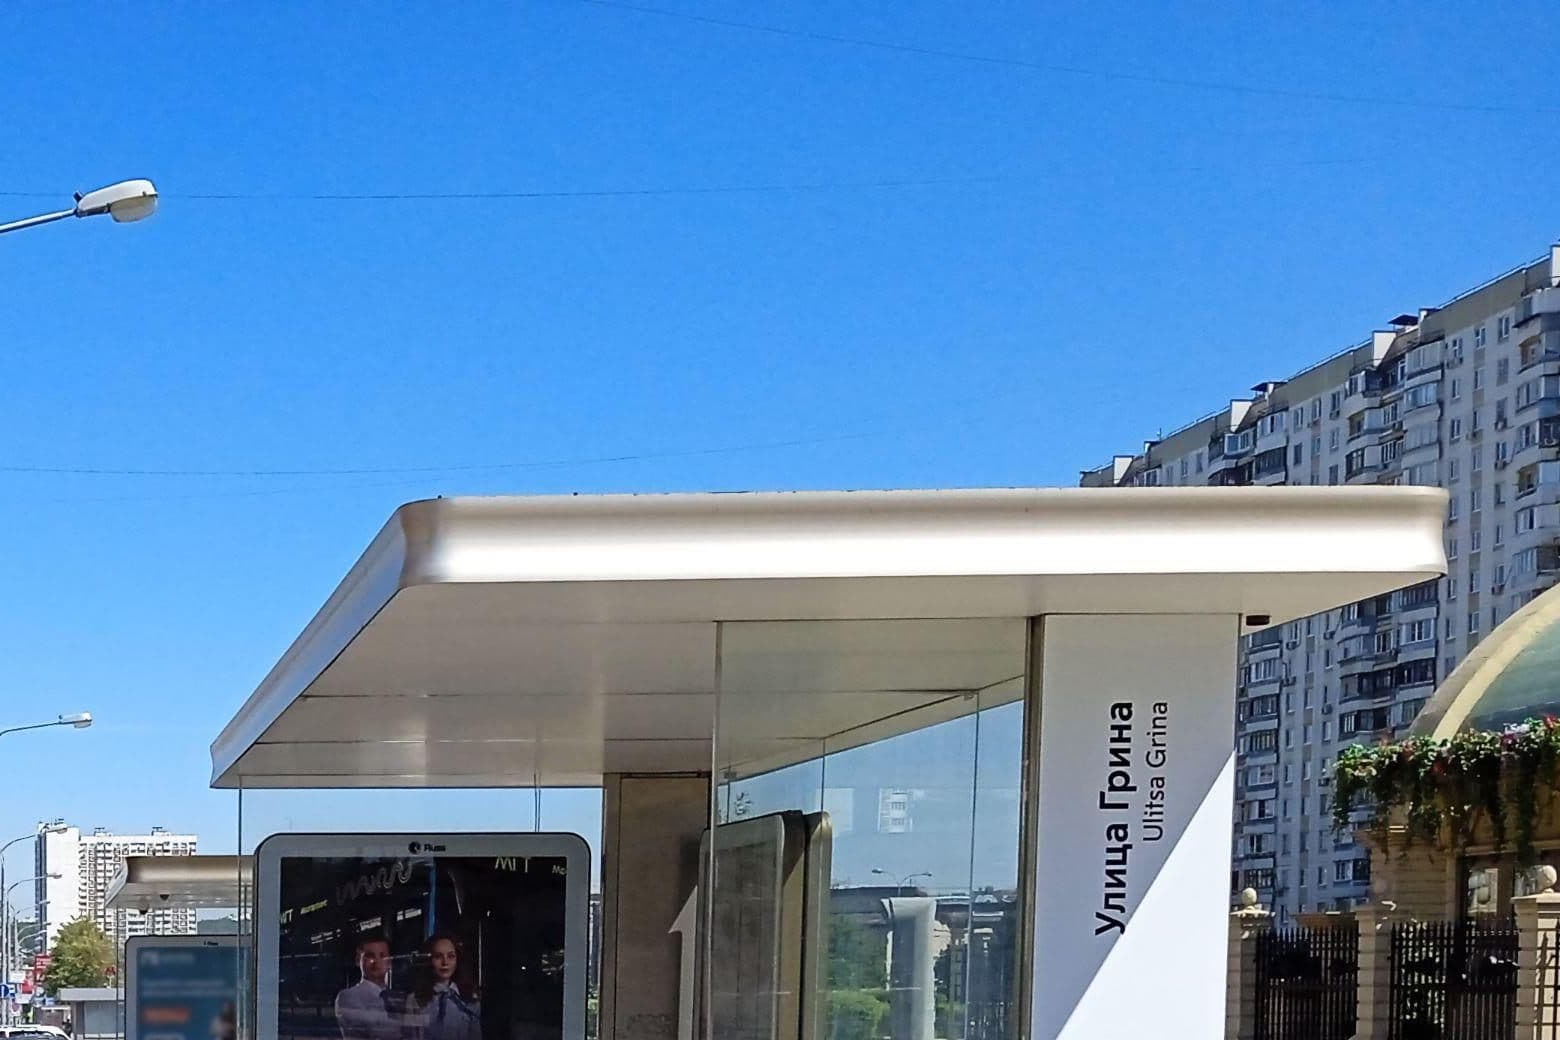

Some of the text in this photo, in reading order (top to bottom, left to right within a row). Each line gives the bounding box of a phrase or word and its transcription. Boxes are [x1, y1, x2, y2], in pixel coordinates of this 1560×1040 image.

[1095, 702, 1137, 936] Улица Грина
[1143, 702, 1169, 841] Ulitsa Grina
